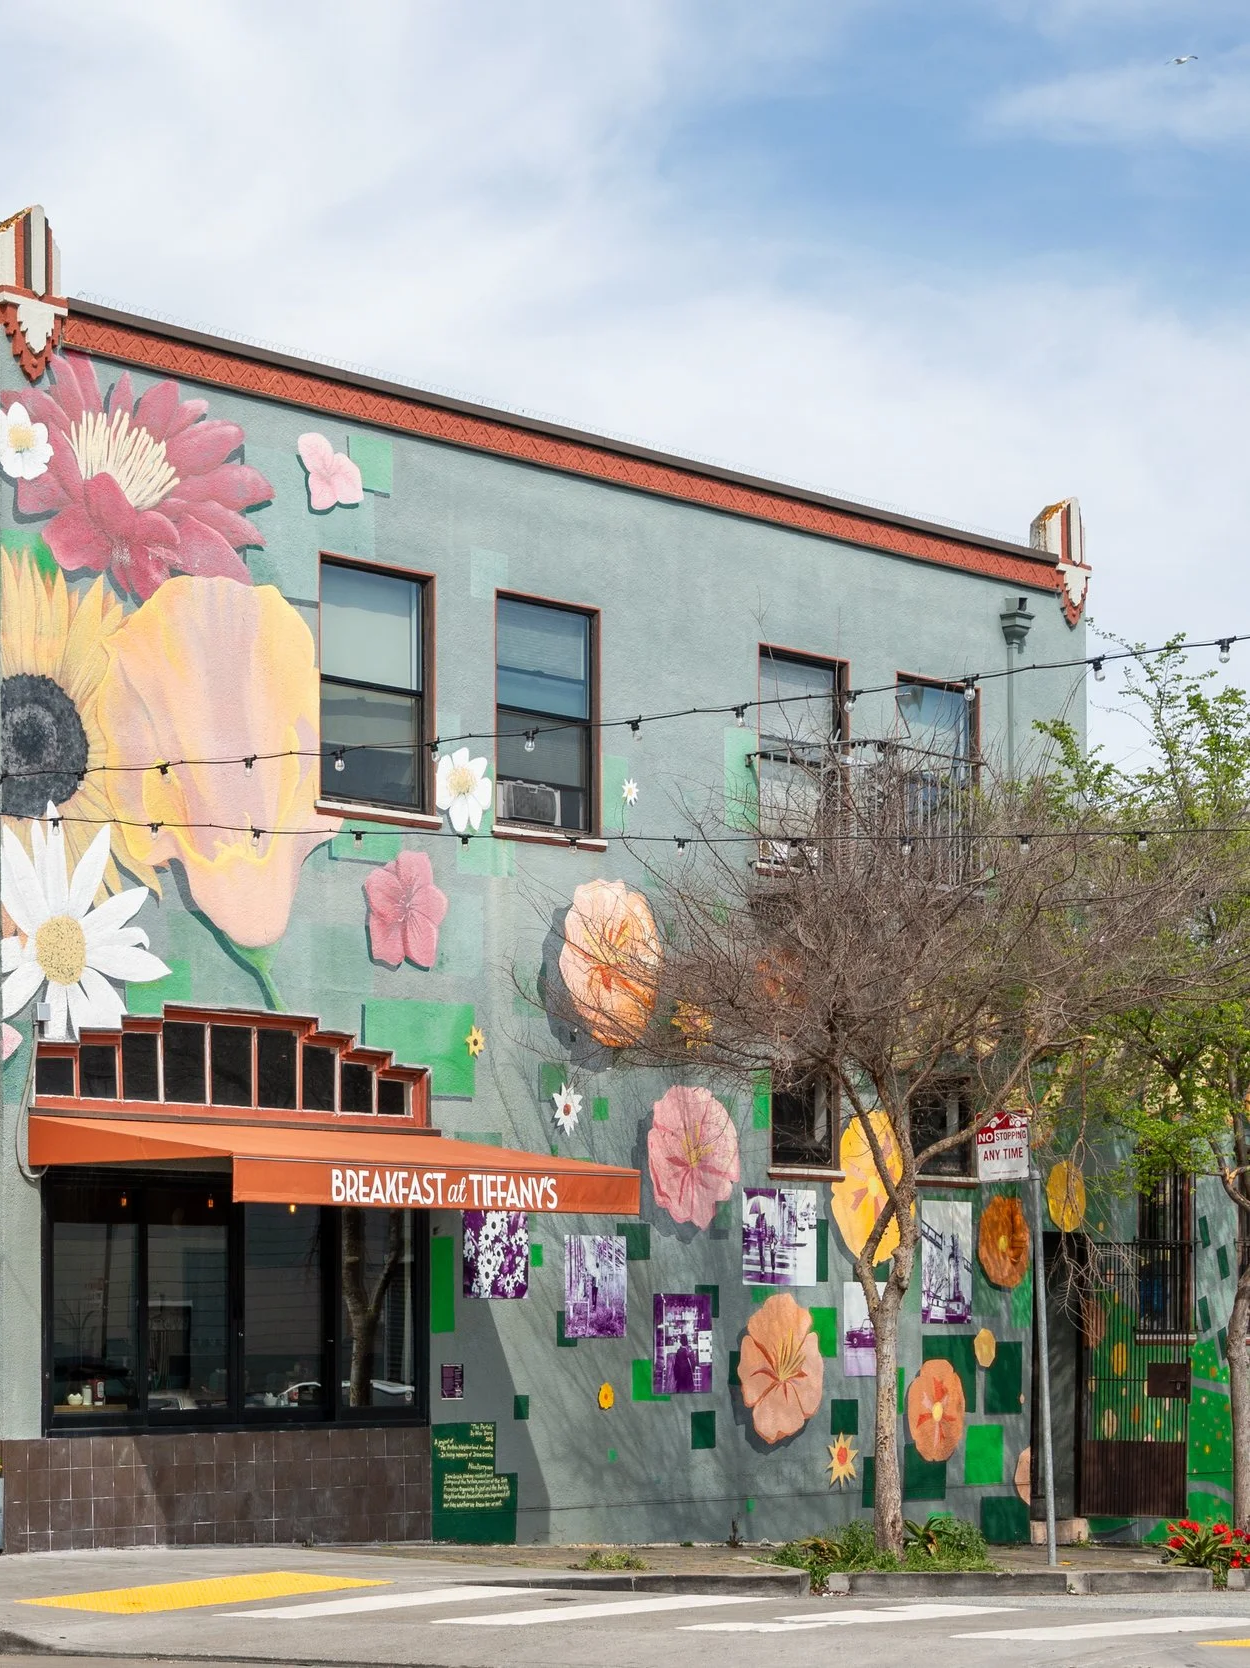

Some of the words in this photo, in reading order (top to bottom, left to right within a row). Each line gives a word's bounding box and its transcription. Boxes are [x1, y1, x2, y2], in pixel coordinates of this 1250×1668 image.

[978, 1133, 994, 1143] NO
[995, 1130, 1027, 1141] STOPPING
[983, 1150, 1001, 1162] ANY
[1003, 1147, 1024, 1160] TIME
[331, 1168, 447, 1205] BREAKFAST
[447, 1176, 468, 1203] at
[468, 1173, 558, 1209] TIFFANY'S
